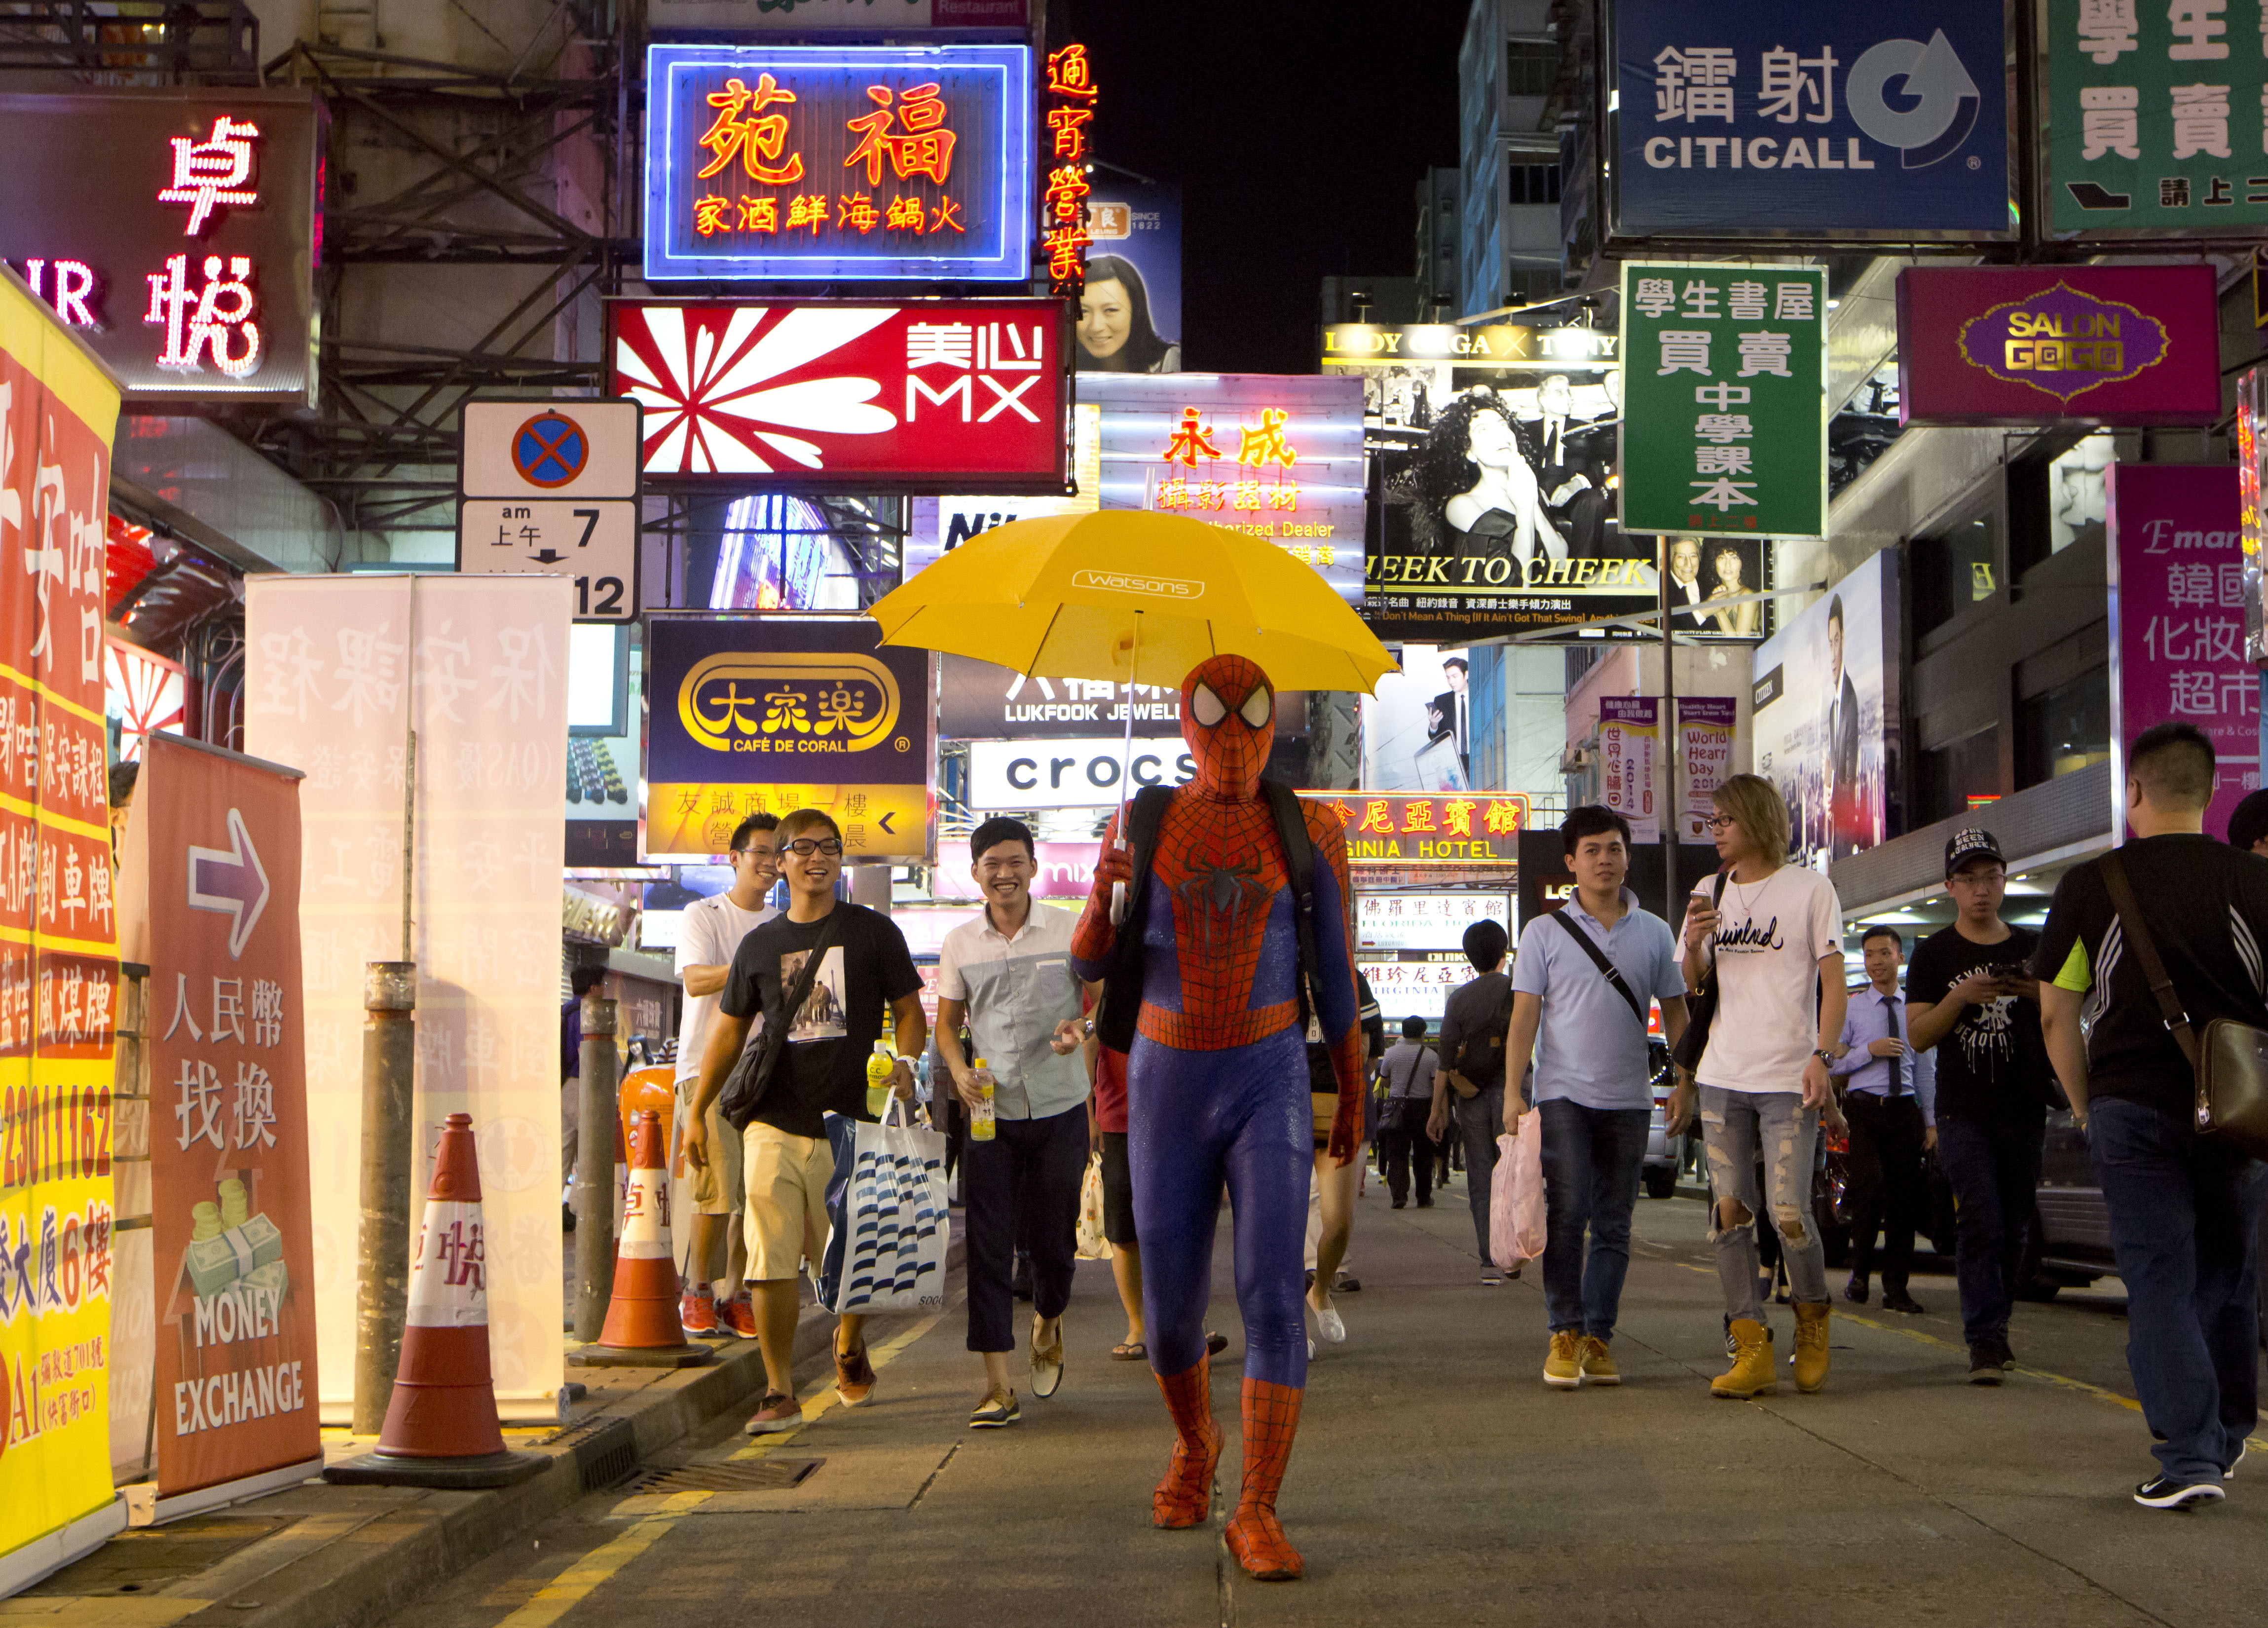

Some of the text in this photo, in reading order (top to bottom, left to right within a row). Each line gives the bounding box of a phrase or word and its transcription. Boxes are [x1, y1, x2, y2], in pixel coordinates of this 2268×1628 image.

[1652, 44, 1840, 124] 鐳射
[1042, 42, 1098, 295] 通宵營業
[1643, 136, 1875, 170] CITICALL
[1131, 213, 1160, 221] SINCE
[1131, 222, 1160, 230] 1822
[143, 115, 260, 373] 卓悅
[1636, 278, 1815, 320] 學生書屋
[2008, 311, 2121, 338] SALON
[907, 322, 1042, 370] 美心
[1325, 332, 1403, 353] LDY
[1657, 330, 1793, 378] 買賣
[2005, 339, 2124, 371] GOGO
[906, 374, 1042, 423] MX
[1162, 406, 1297, 470] 永成
[1689, 381, 1759, 512] 中學課本
[1156, 477, 1302, 512] 攝影器材
[502, 507, 531, 519] am
[573, 509, 600, 547] 7
[1282, 521, 1335, 537] Dealer
[490, 525, 541, 547] 上午
[1277, 544, 1335, 566] 銷商
[1461, 558, 1511, 584] TO
[1522, 558, 1652, 585] CHEEK
[575, 576, 624, 614] 12
[1087, 571, 1190, 596] Watsons
[2167, 562, 2236, 610] 韓國
[1382, 611, 1406, 620] Don't
[1409, 612, 1434, 621] Mean
[1436, 612, 1444, 620] A
[1445, 612, 1471, 623] Thing
[1491, 612, 1512, 622] Ain't
[1514, 613, 1529, 622] Got
[1531, 613, 1553, 623] That
[1416, 598, 1459, 608] 紐約錄音
[2143, 615, 2241, 662] 化妝
[1755, 680, 1774, 705] CITIZEN
[2169, 669, 2260, 717] 超市
[1004, 704, 1099, 722] LUKFOOK
[733, 736, 847, 753] CAFÉ DE CORAL
[1687, 731, 1726, 744] World
[1688, 747, 1726, 760] Heart
[44, 717, 106, 808] 保安課程
[1006, 754, 1198, 790] crocs
[1689, 762, 1713, 776] Day
[1626, 758, 1635, 809] 2014
[2214, 771, 2260, 791] 一樓
[677, 790, 867, 818] 友誠商場一樓
[1419, 840, 1498, 858] HOTEL
[1363, 898, 1503, 917] 佛羅里達賓館
[163, 971, 285, 1050] 人民幣
[173, 1057, 279, 1151] 找換
[3, 1085, 111, 1188] 23011162
[195, 1286, 280, 1348] MONEY
[10, 1353, 41, 1446] A1
[176, 1360, 304, 1436] EXCHANGE
